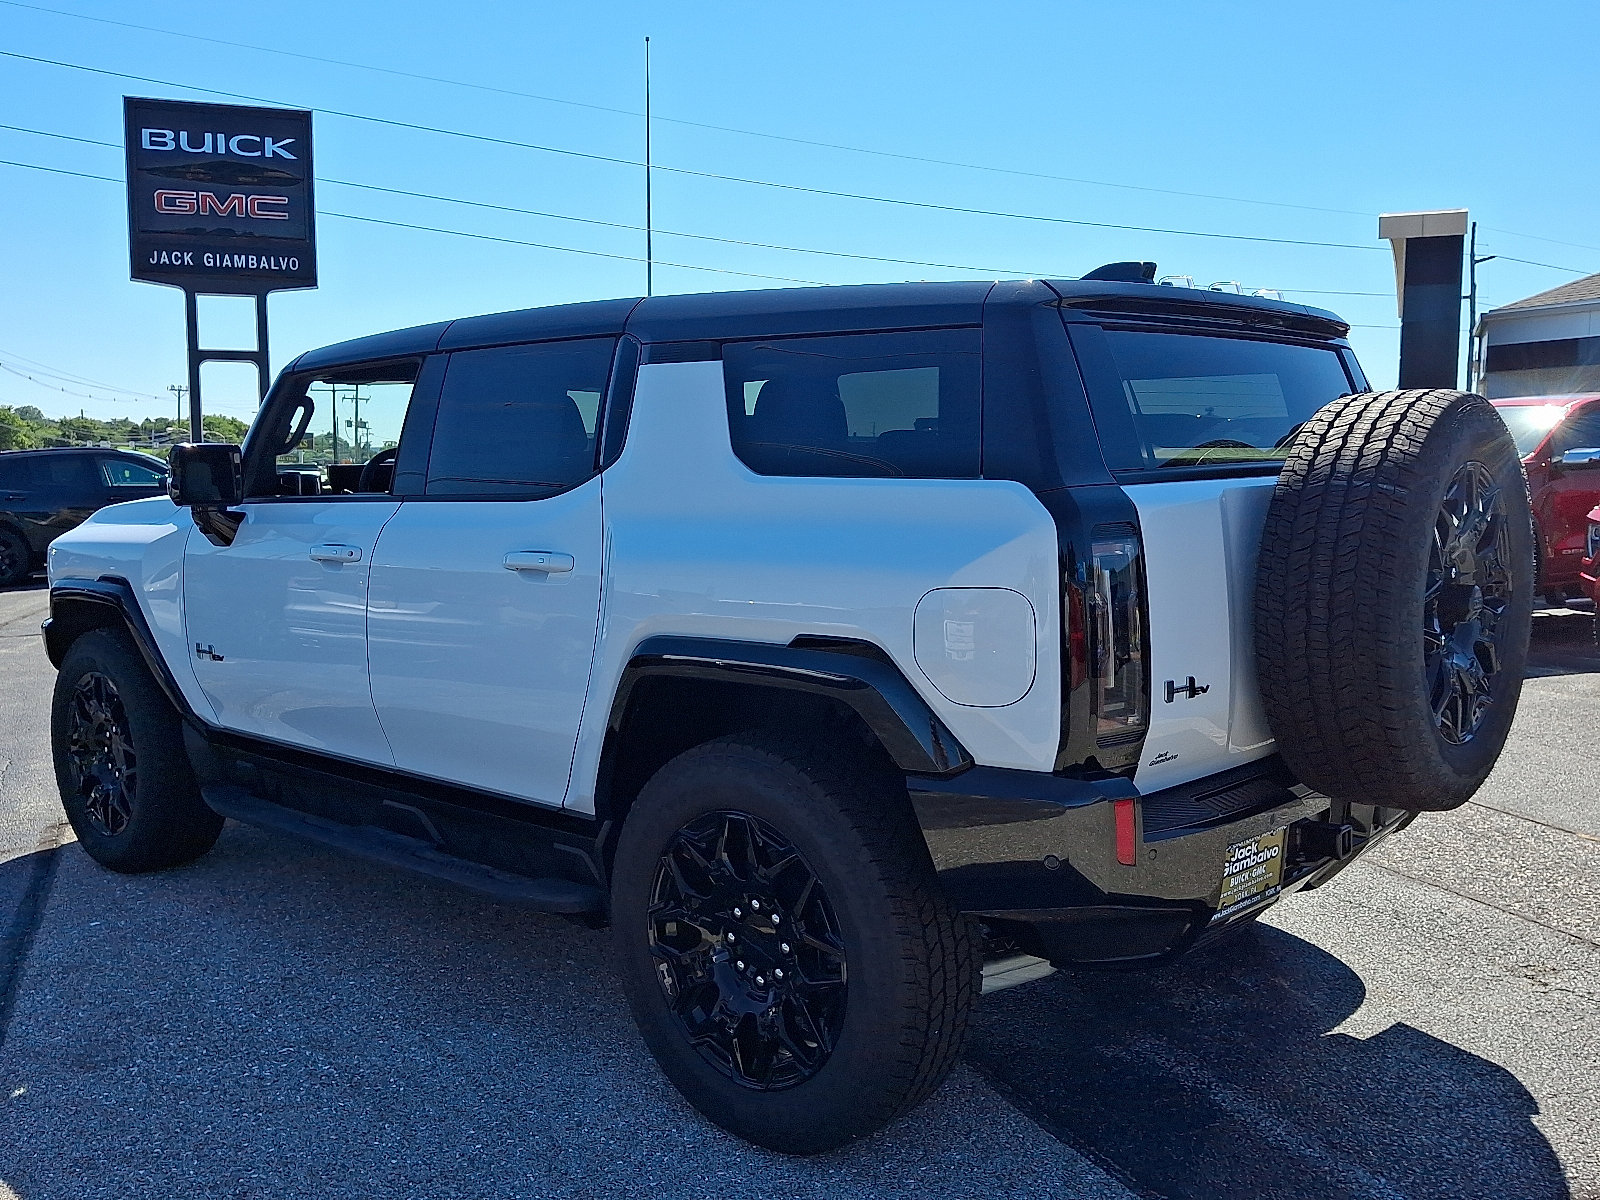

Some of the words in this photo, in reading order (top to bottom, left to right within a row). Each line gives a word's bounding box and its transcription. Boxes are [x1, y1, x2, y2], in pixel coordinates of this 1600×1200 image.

[141, 128, 298, 160] BUICK
[154, 189, 289, 220] GMC
[150, 251, 194, 266] JACK
[203, 253, 300, 271] GIAMBALVO
[1231, 842, 1259, 862] Jack
